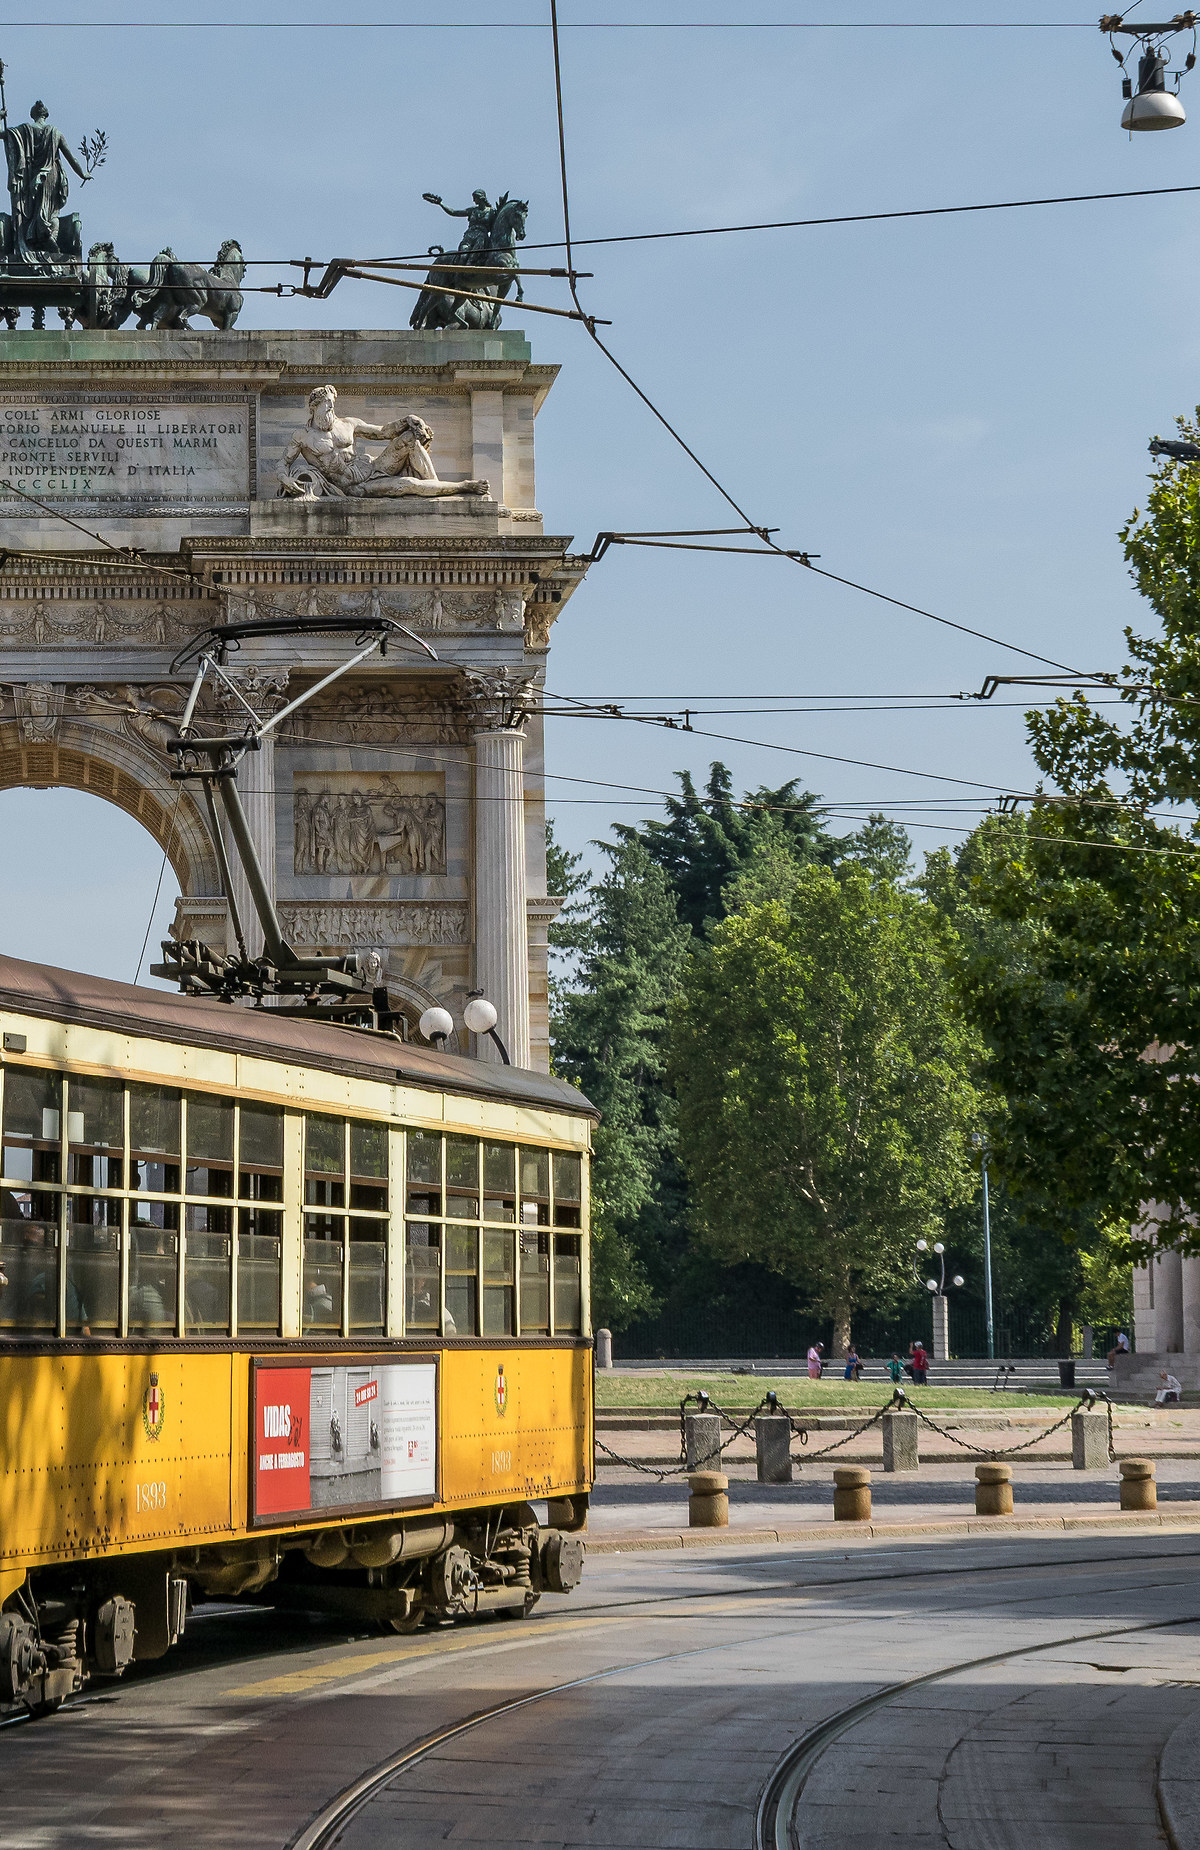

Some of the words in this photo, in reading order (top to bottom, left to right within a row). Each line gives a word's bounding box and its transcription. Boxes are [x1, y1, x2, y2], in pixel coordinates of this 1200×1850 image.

[50, 410, 84, 421] ARMI
[96, 410, 160, 421] GLORIOSE
[51, 424, 125, 434] EMANUELE
[137, 424, 146, 434] II
[158, 424, 242, 434] LIBERATORI
[89, 438, 106, 448] DA
[116, 438, 163, 448] QUESTI
[173, 438, 218, 448] MARMI
[67, 452, 119, 462] SERVILI
[9, 466, 115, 476] INDIPENDENZA
[149, 466, 195, 476] ITALIA
[263, 1404, 291, 1438] VIDAS
[491, 1450, 512, 1474] 1893
[136, 1481, 166, 1513] 1893
